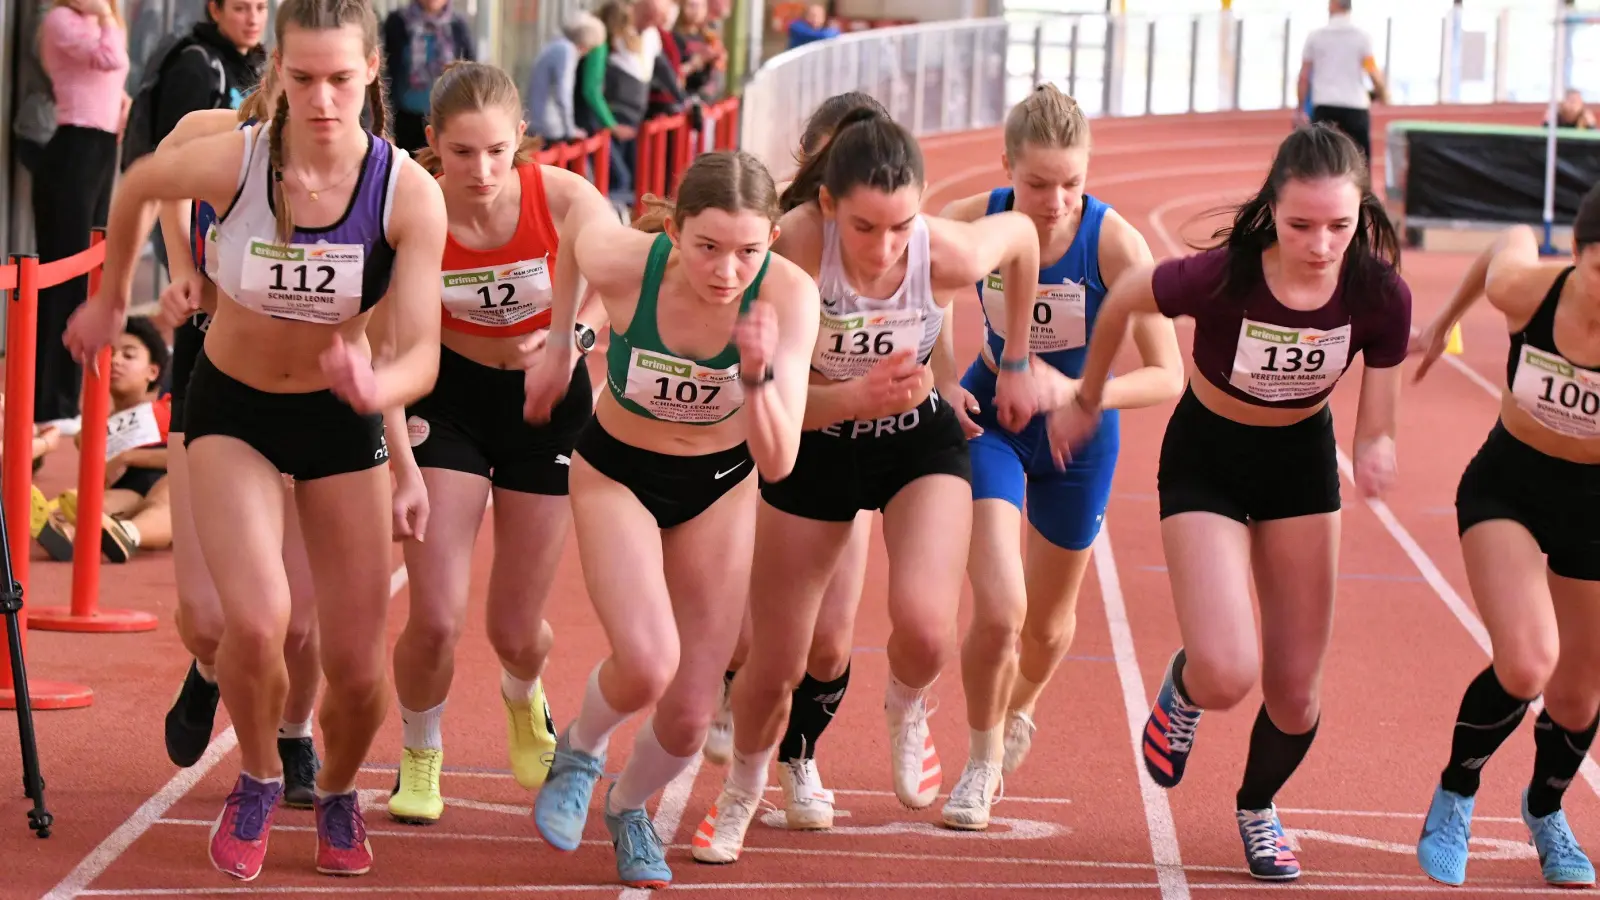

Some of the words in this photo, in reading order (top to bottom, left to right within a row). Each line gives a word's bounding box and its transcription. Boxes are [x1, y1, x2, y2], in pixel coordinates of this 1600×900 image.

[526, 266, 543, 275] SPORTS
[268, 264, 336, 294] 112
[448, 276, 478, 284] erima
[268, 292, 302, 302] SCHMID
[304, 295, 335, 304] LEONIE
[477, 283, 518, 308] 12
[506, 302, 533, 312] NAOMI
[1251, 328, 1281, 340] erima
[828, 330, 894, 355] 136
[642, 359, 672, 372] erima
[1260, 346, 1326, 372] 139
[1250, 372, 1295, 381] VERETILNIK
[654, 376, 720, 404] 107
[1538, 376, 1600, 415] 100
[649, 400, 688, 409] SCHINKO
[851, 408, 920, 438] PRO
